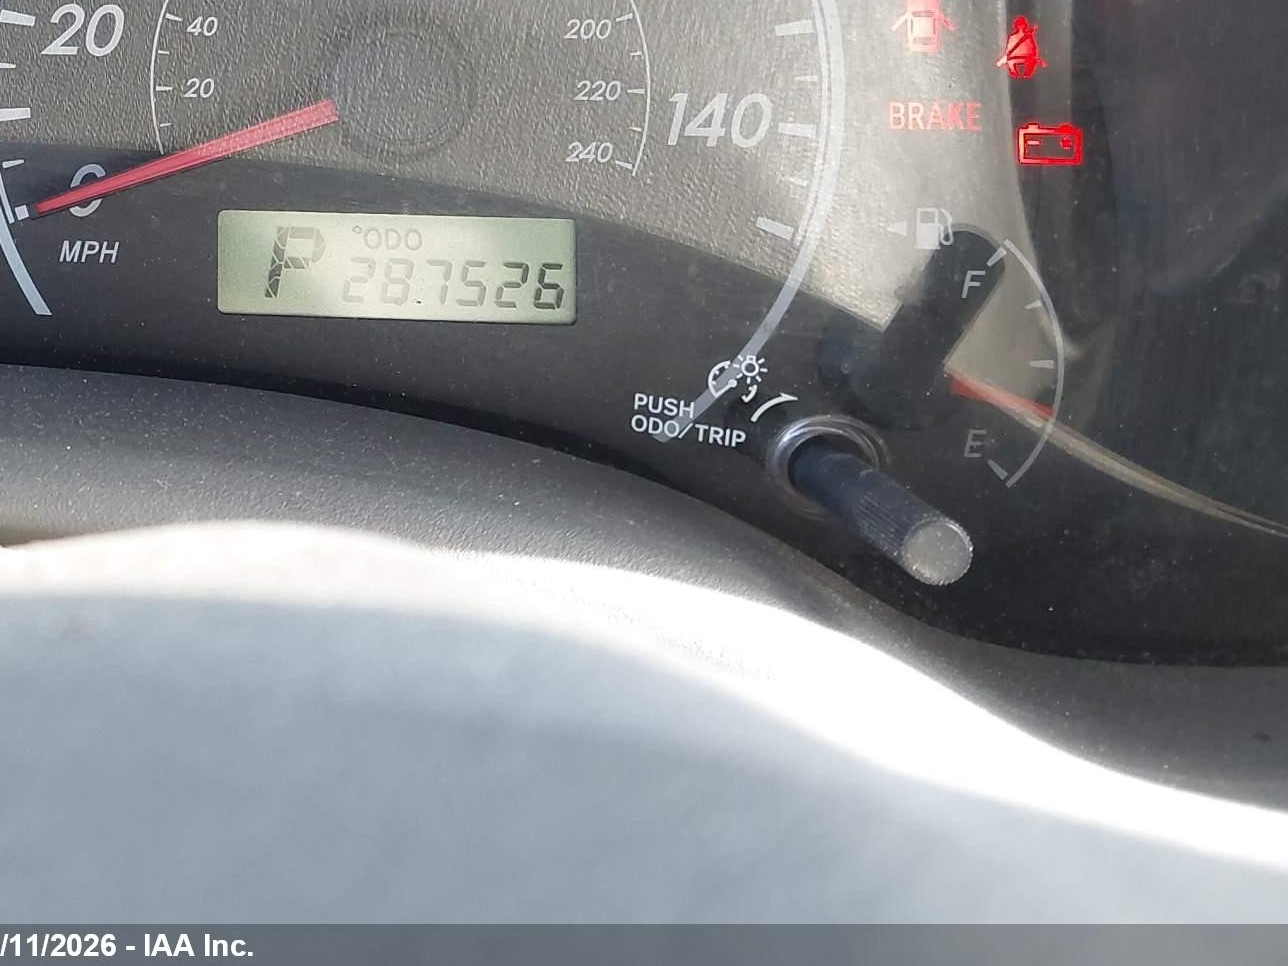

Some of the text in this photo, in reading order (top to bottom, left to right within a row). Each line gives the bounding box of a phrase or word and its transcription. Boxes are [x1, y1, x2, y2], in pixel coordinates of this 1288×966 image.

[41, 3, 124, 57] 20
[186, 16, 219, 37] 40
[564, 19, 612, 41] 200
[184, 78, 215, 99] 20
[575, 80, 621, 102] 220
[665, 92, 772, 148] 140
[888, 102, 982, 130] BRAKE
[565, 142, 614, 164] 240
[59, 241, 119, 265] MPH
[264, 227, 326, 298] P
[342, 256, 564, 310] 287526
[961, 270, 985, 299] F
[633, 392, 695, 419] PUSH
[631, 414, 747, 447] ODO/TRIP
[963, 430, 984, 459] E
